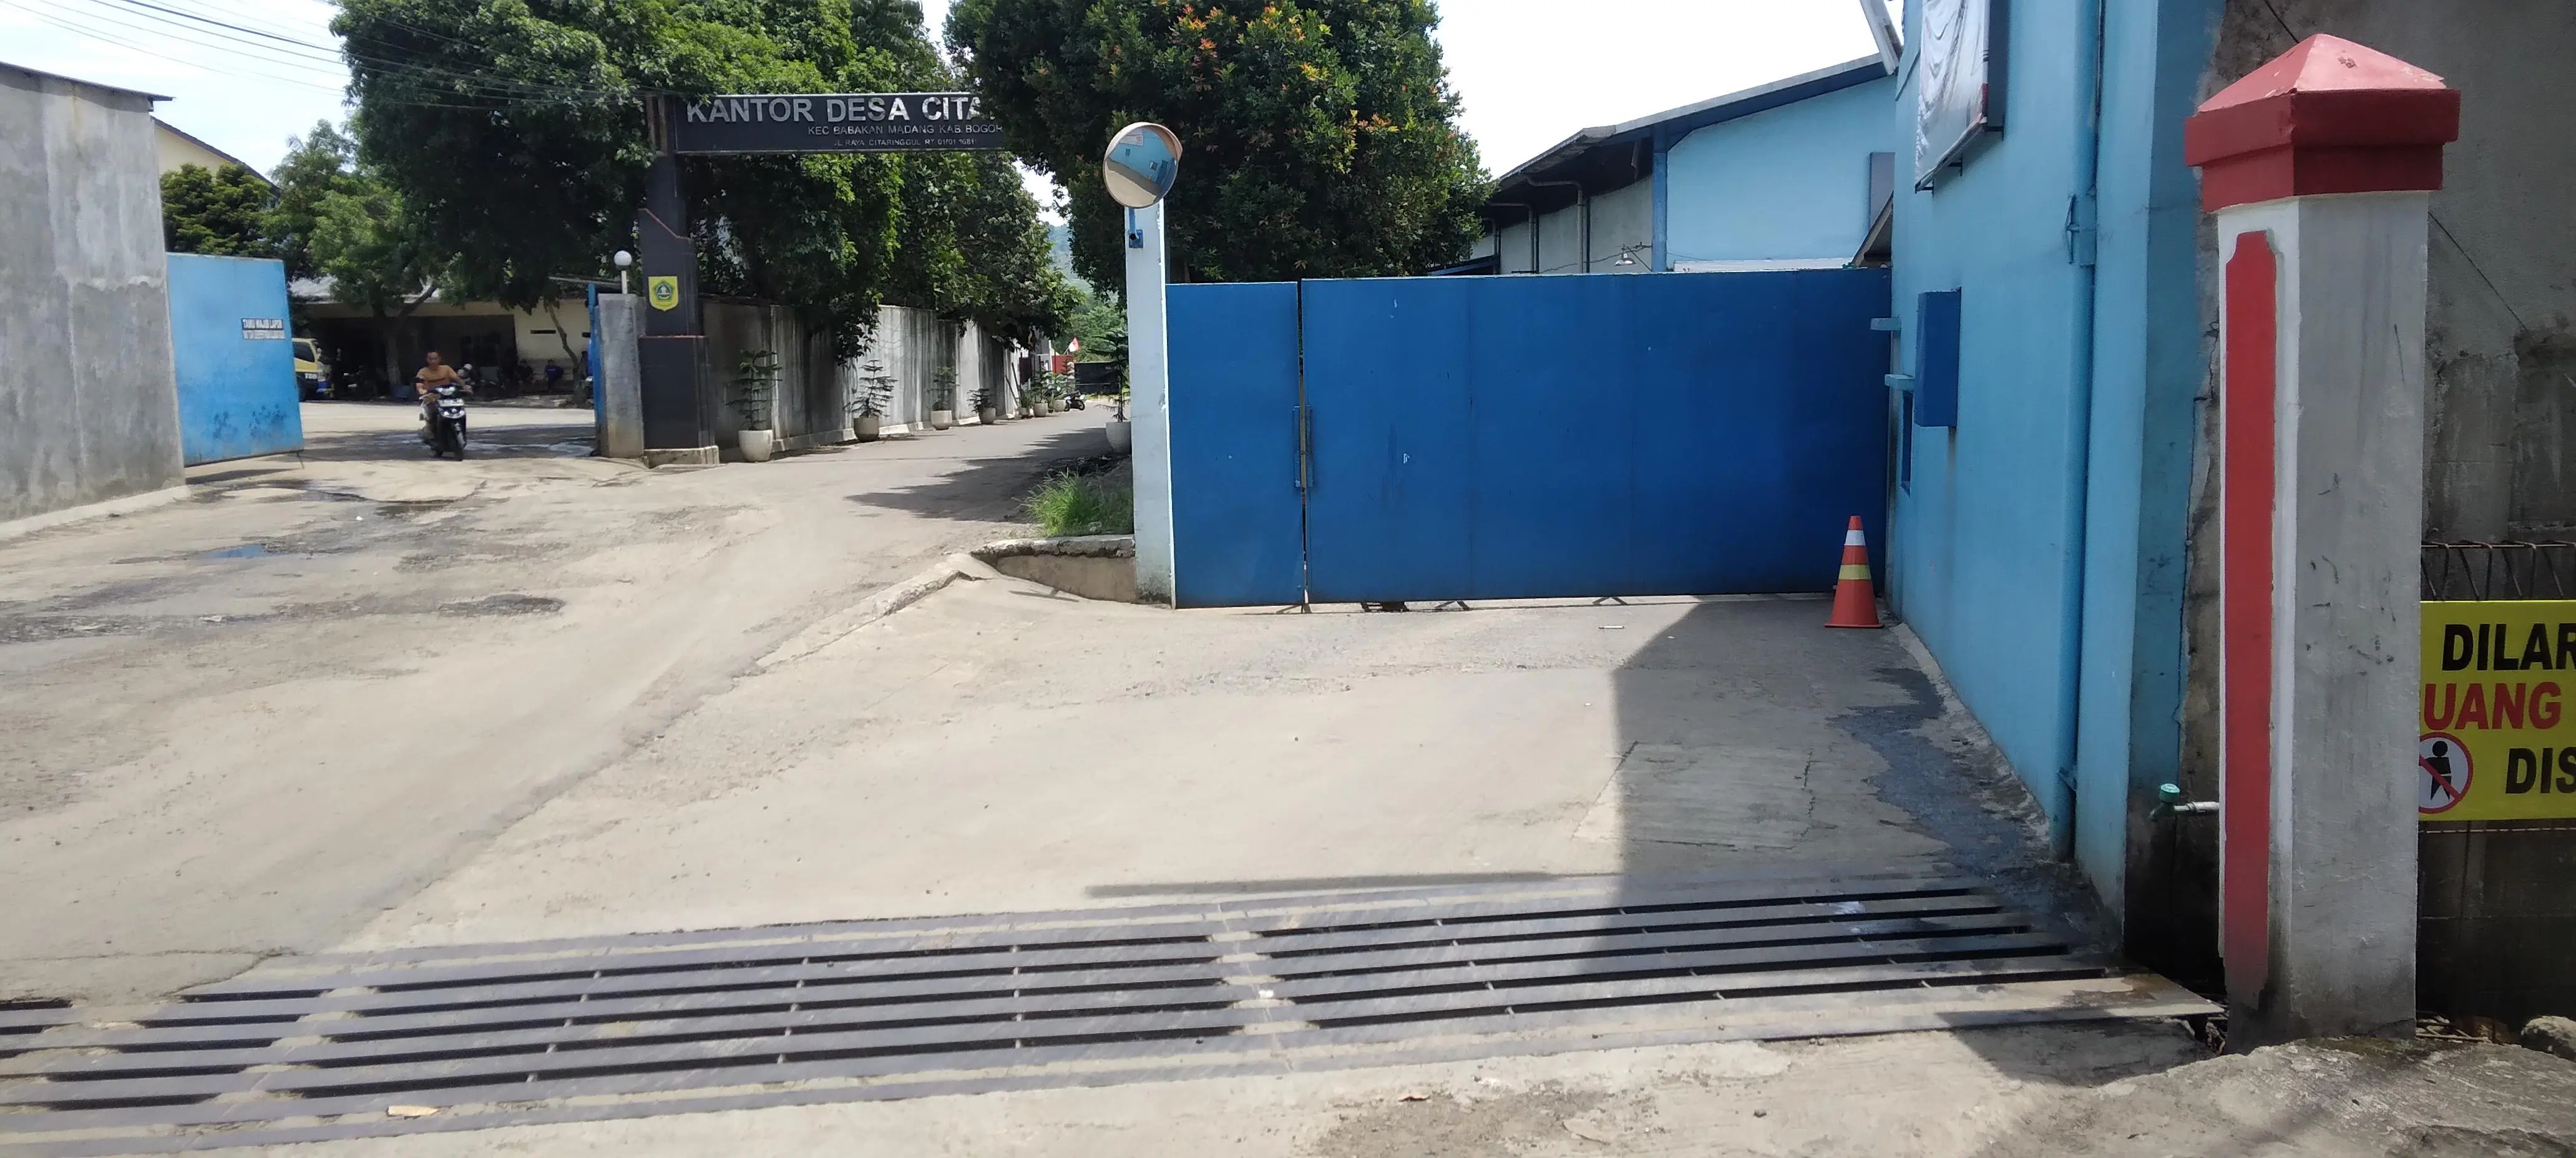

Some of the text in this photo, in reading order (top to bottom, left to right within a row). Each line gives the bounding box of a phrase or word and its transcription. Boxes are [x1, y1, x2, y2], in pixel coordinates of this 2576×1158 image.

[687, 97, 996, 122] KANTOR DESA CITA
[833, 125, 883, 135] BABAKAN
[888, 125, 934, 134] MADANG
[965, 124, 1003, 133] BOGOR
[2424, 681, 2562, 731] UANG
